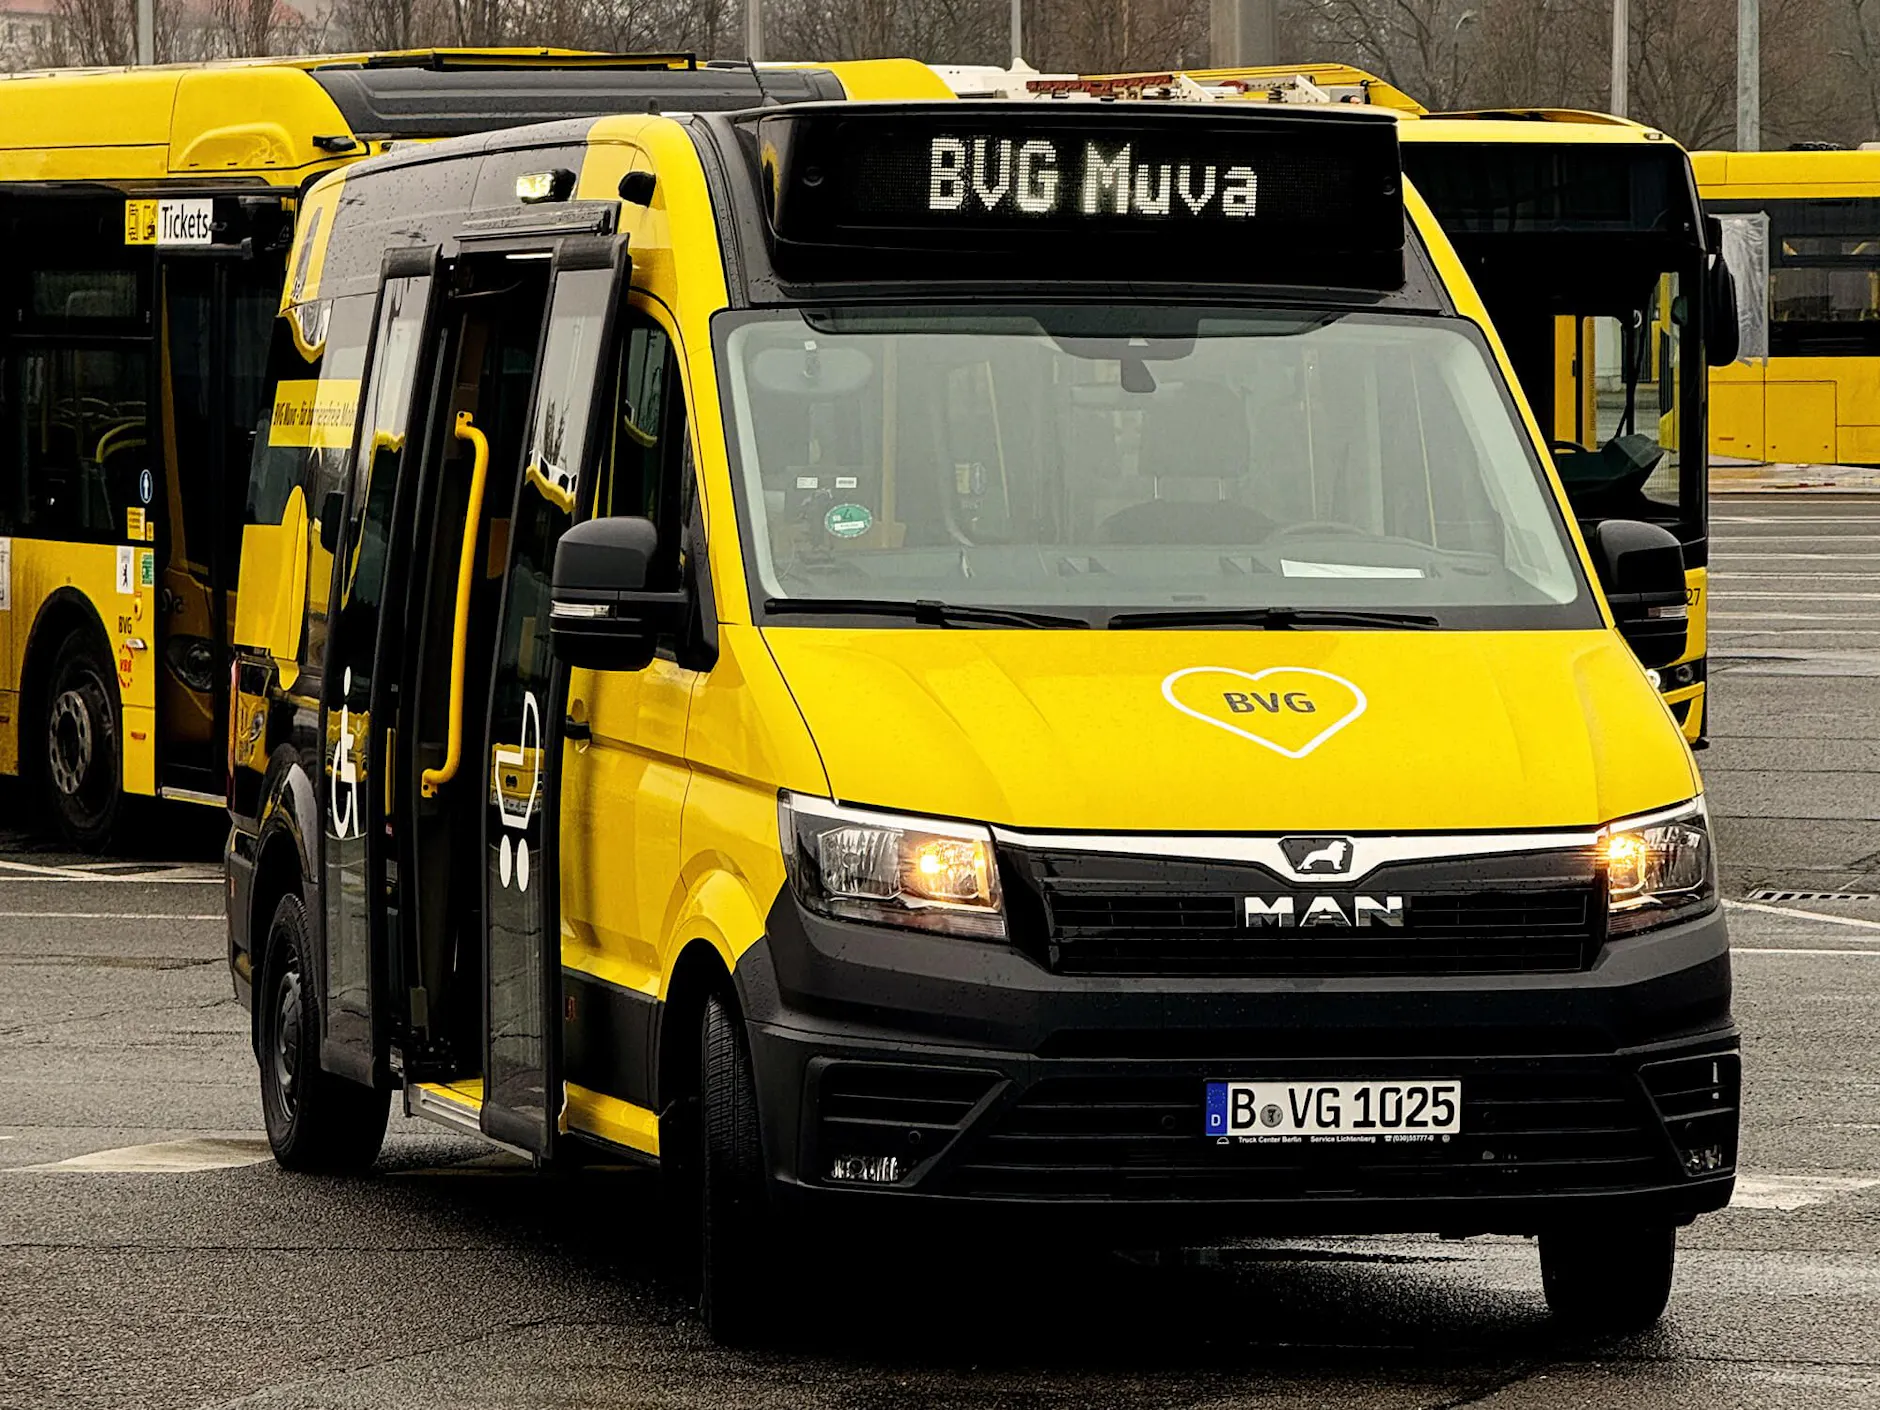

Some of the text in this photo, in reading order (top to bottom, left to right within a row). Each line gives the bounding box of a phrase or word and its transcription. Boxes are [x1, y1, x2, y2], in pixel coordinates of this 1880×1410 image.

[929, 137, 1258, 217] BVG Muva
[162, 204, 208, 239] Tickets
[118, 616, 132, 634] BVG
[1223, 692, 1316, 713] BVG
[1244, 896, 1404, 927] MAN
[1210, 1114, 1221, 1126] D
[1231, 1086, 1456, 1129] B VG 1025
[1336, 1135, 1376, 1143] Lichtenberg
